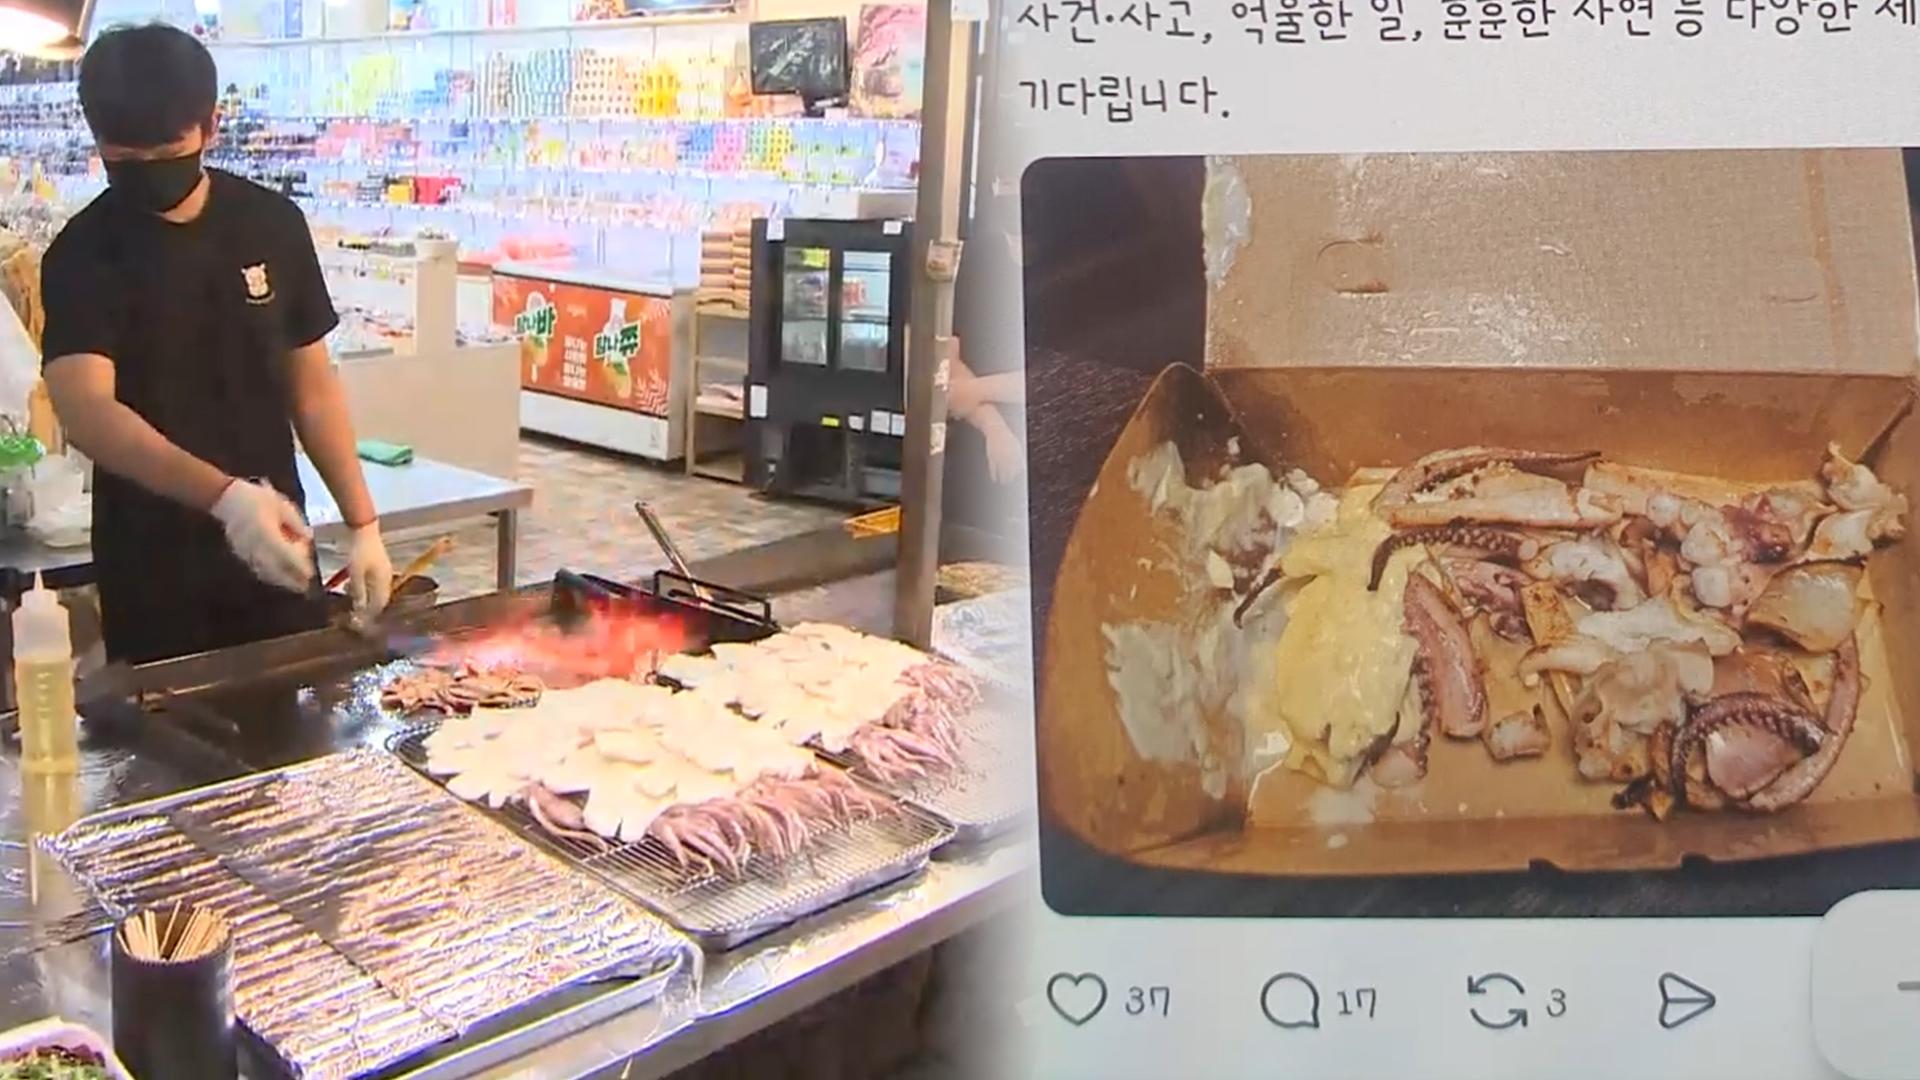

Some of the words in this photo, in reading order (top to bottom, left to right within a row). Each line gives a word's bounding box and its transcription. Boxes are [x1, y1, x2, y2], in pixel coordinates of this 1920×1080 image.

[1231, 0, 1353, 44] 억울한
[1370, 0, 1422, 42] 일,
[1441, 0, 1556, 40] 훈훈한
[1573, 0, 1652, 37] 사연
[1726, 0, 1858, 34] 다양한
[1018, 75, 1230, 123] 기다립니다.
[1125, 986, 1170, 1017] 37
[1337, 988, 1376, 1018] 17
[1546, 988, 1567, 1017] 3
